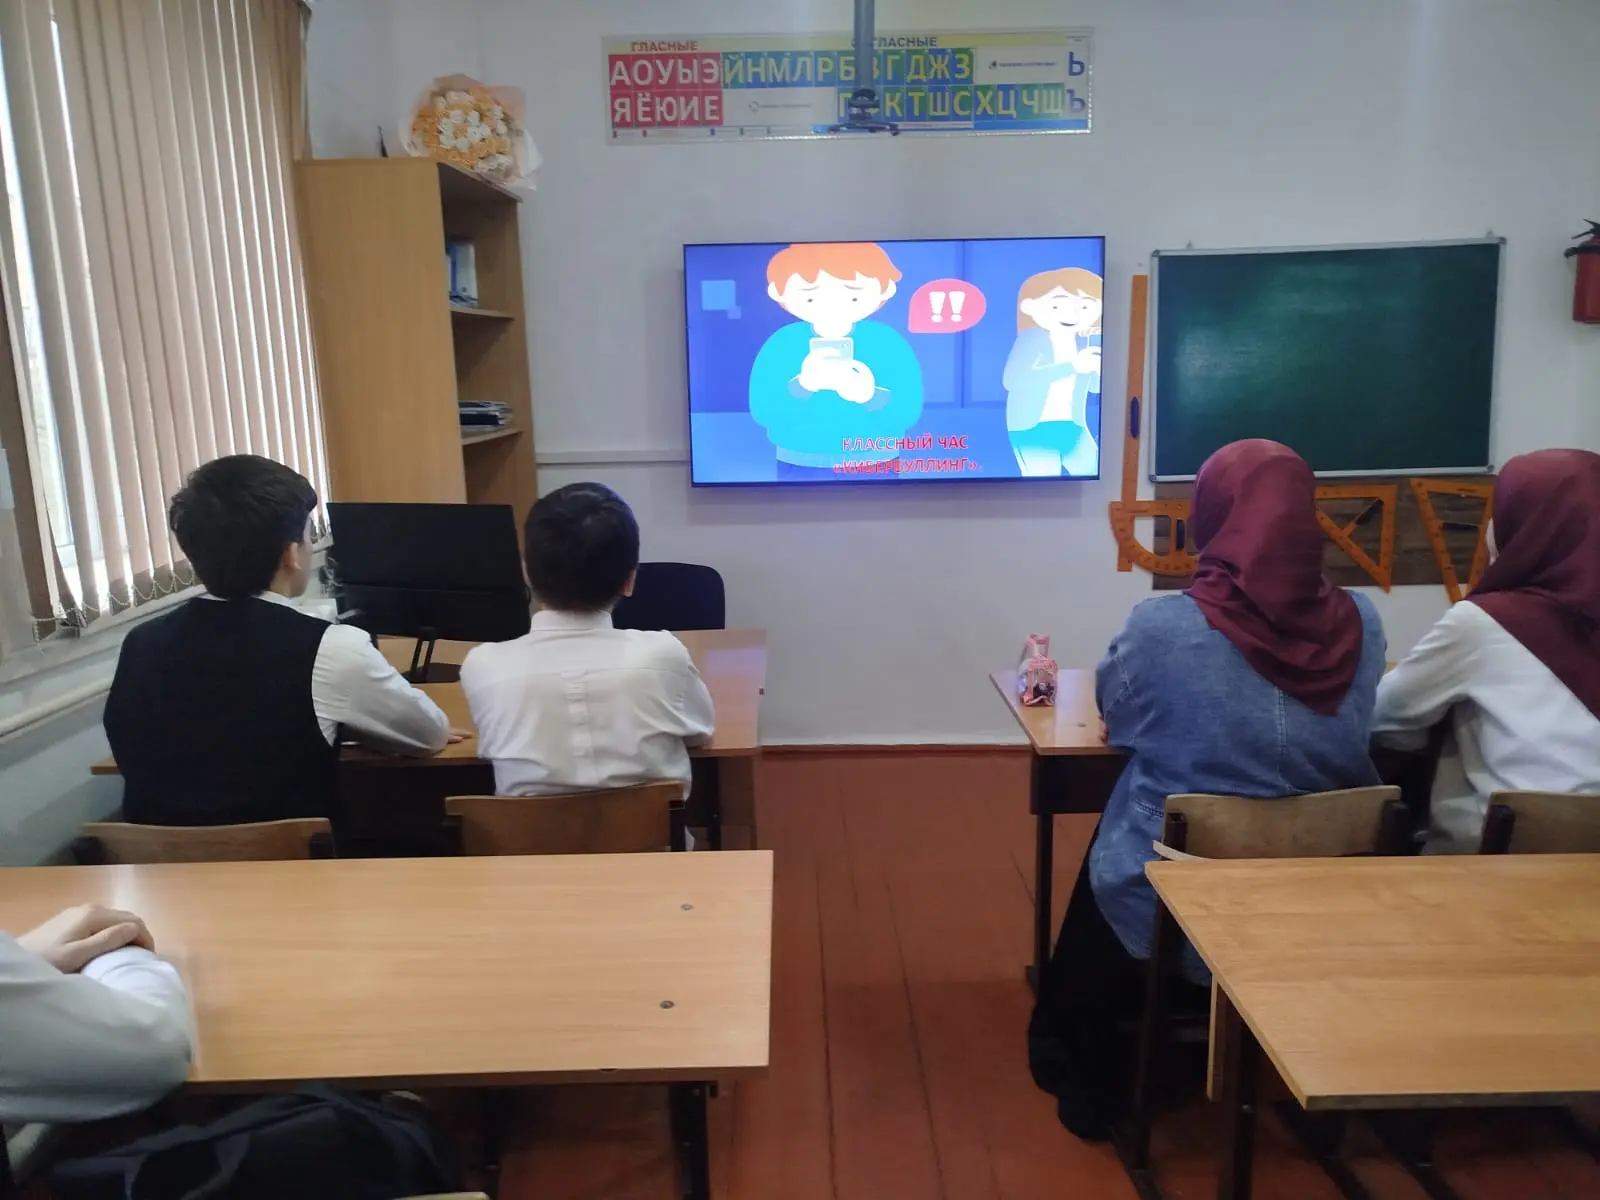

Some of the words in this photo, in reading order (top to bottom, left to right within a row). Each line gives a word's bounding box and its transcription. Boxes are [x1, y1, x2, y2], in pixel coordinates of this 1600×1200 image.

[631, 41, 698, 52] ГЛАСНЫЕ
[842, 432, 933, 452] КЛАССНЫЙ
[937, 435, 969, 450] ЧАС
